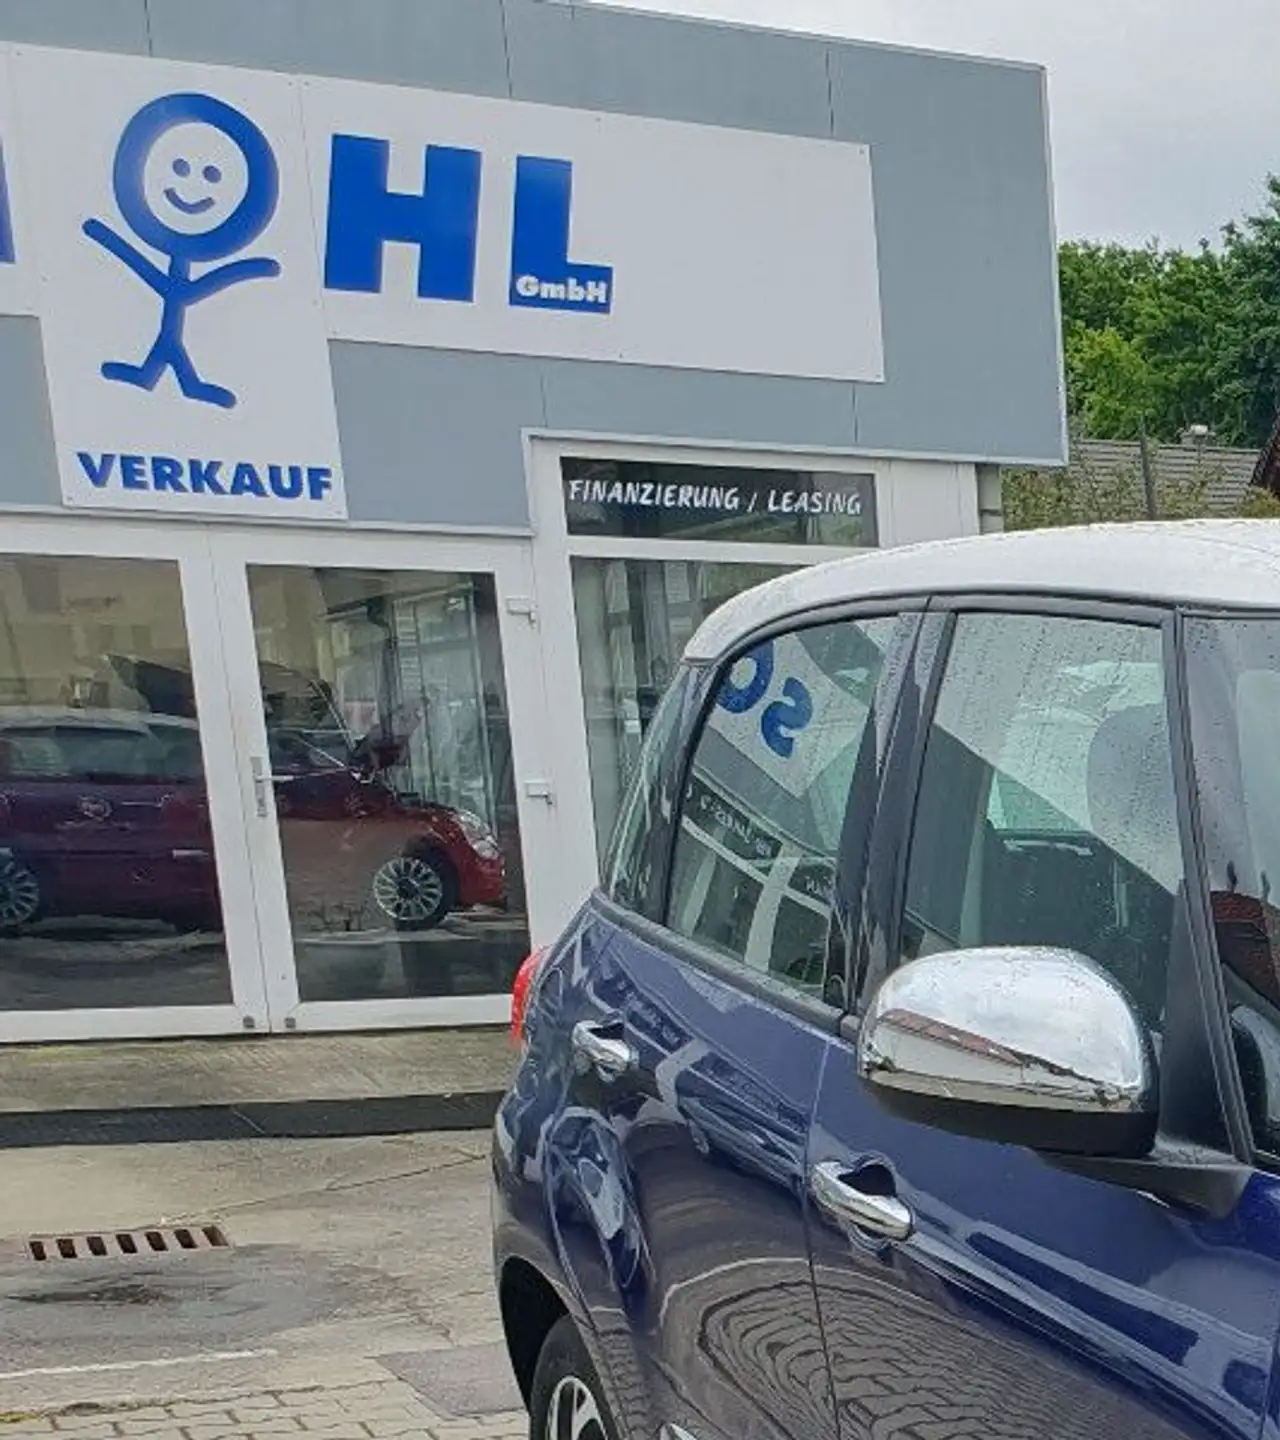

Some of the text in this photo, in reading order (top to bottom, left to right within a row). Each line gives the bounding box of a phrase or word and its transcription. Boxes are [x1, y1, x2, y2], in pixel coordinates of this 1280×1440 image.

[516, 275, 607, 303] GmbH
[77, 451, 333, 501] VERKAUF
[569, 479, 740, 511] FINANZIERUNG
[768, 489, 862, 515] LEASING
